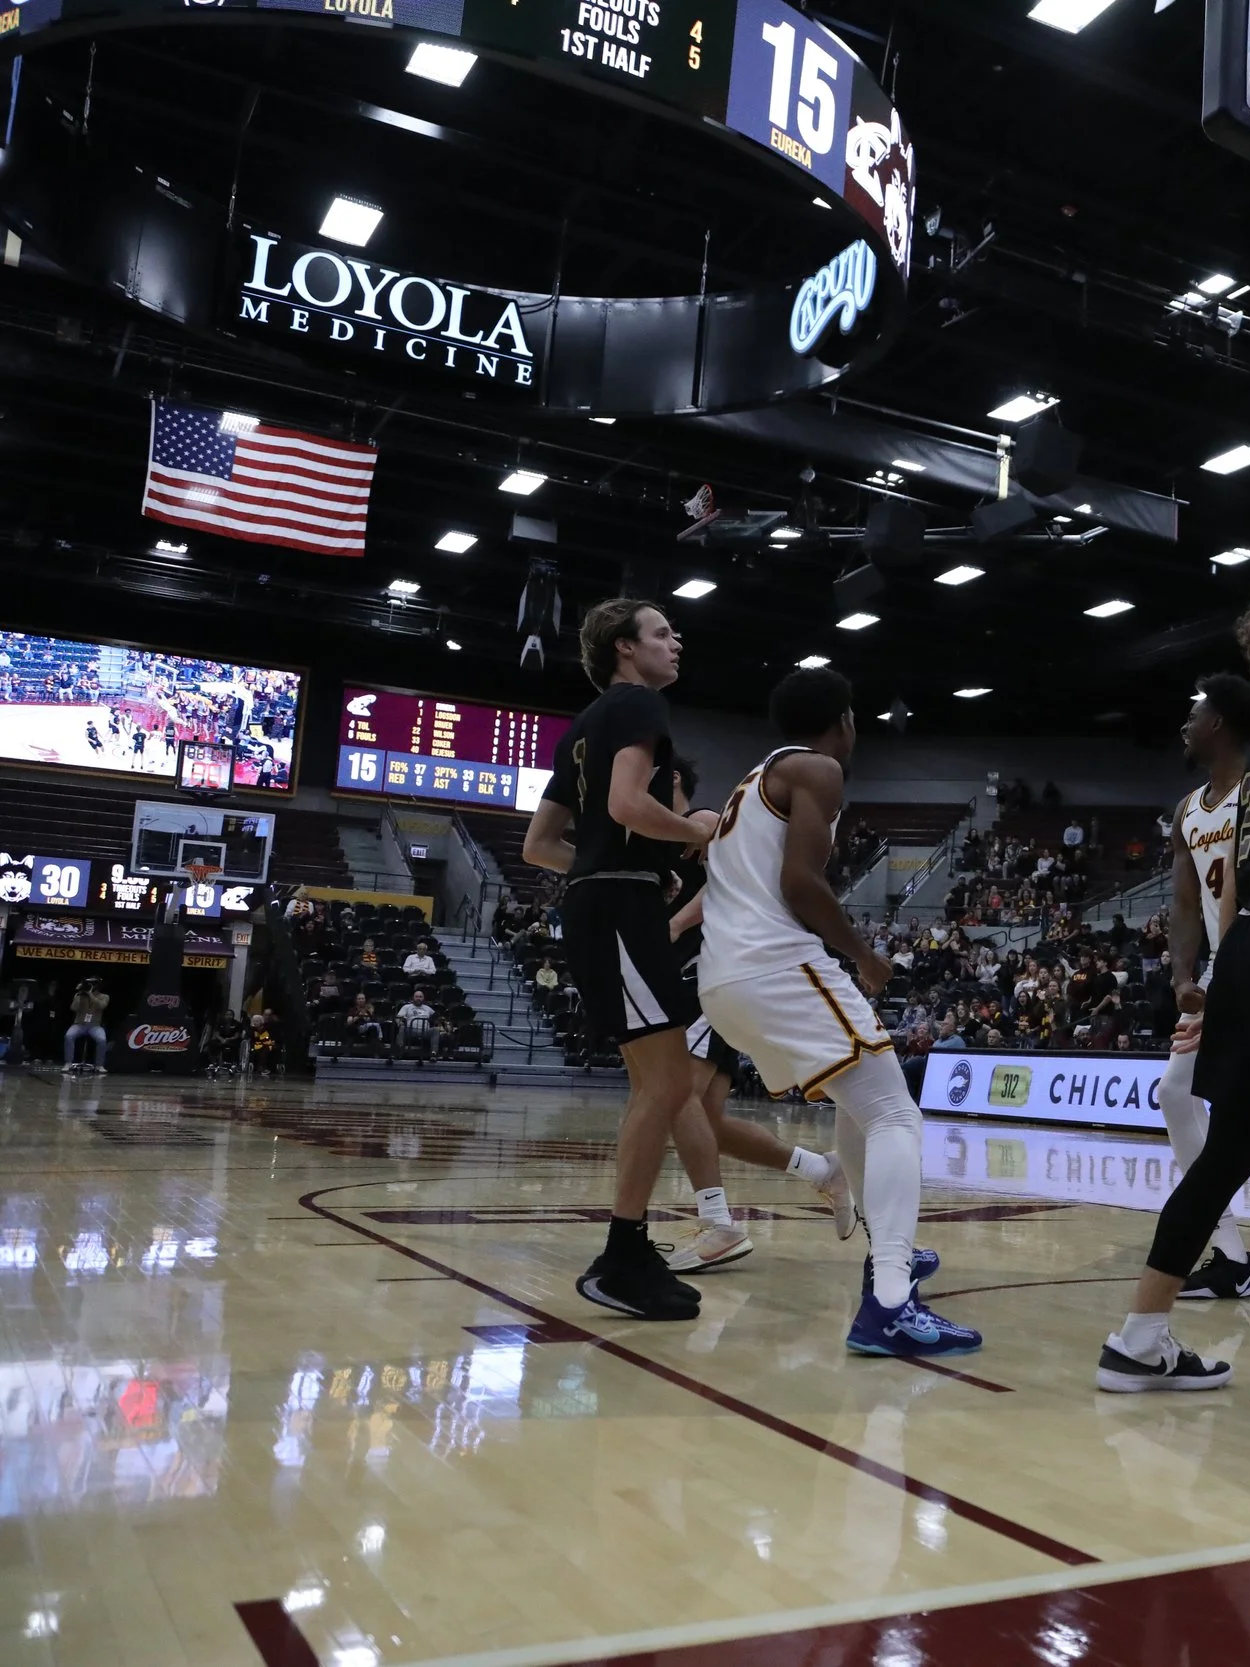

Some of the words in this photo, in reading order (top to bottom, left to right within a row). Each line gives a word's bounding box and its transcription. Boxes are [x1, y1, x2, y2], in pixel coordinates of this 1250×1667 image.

[324, 0, 393, 19] LOYOLA
[578, 2, 641, 45] FOULS
[688, 45, 701, 70] 5
[690, 20, 703, 43] 4
[561, 28, 599, 60] 1ST
[601, 40, 652, 78] HALF
[762, 21, 838, 155] 15
[770, 128, 812, 169] EUREKA
[243, 234, 533, 357] LOYOLA
[239, 296, 532, 386] MEDICINE
[412, 726, 421, 735] 22
[348, 752, 377, 782] 15
[390, 761, 408, 773] FG%
[414, 763, 427, 775] 37
[434, 766, 458, 779] 3PT%
[479, 771, 497, 784] FT%
[388, 773, 405, 785] REB
[415, 775, 424, 787] 5
[433, 777, 450, 790] AST
[478, 783, 494, 795] BLK
[40, 864, 80, 898] 30
[185, 883, 215, 908] 15
[101, 883, 107, 891] 3
[112, 883, 147, 895] TIMEOUTS
[151, 887, 157, 895] 4
[1205, 857, 1225, 900] 4
[46, 896, 70, 905] LOYOLA
[100, 891, 106, 899] 4
[117, 892, 140, 901] FOULS
[115, 901, 125, 909] 1ST
[23, 948, 42, 956] WE
[45, 949, 75, 959] ALSO
[80, 951, 113, 961] TREAT
[117, 953, 137, 962] THE
[188, 957, 221, 967] SPIRIT
[128, 1024, 191, 1050] Cane's
[1001, 1073, 1020, 1099] 312
